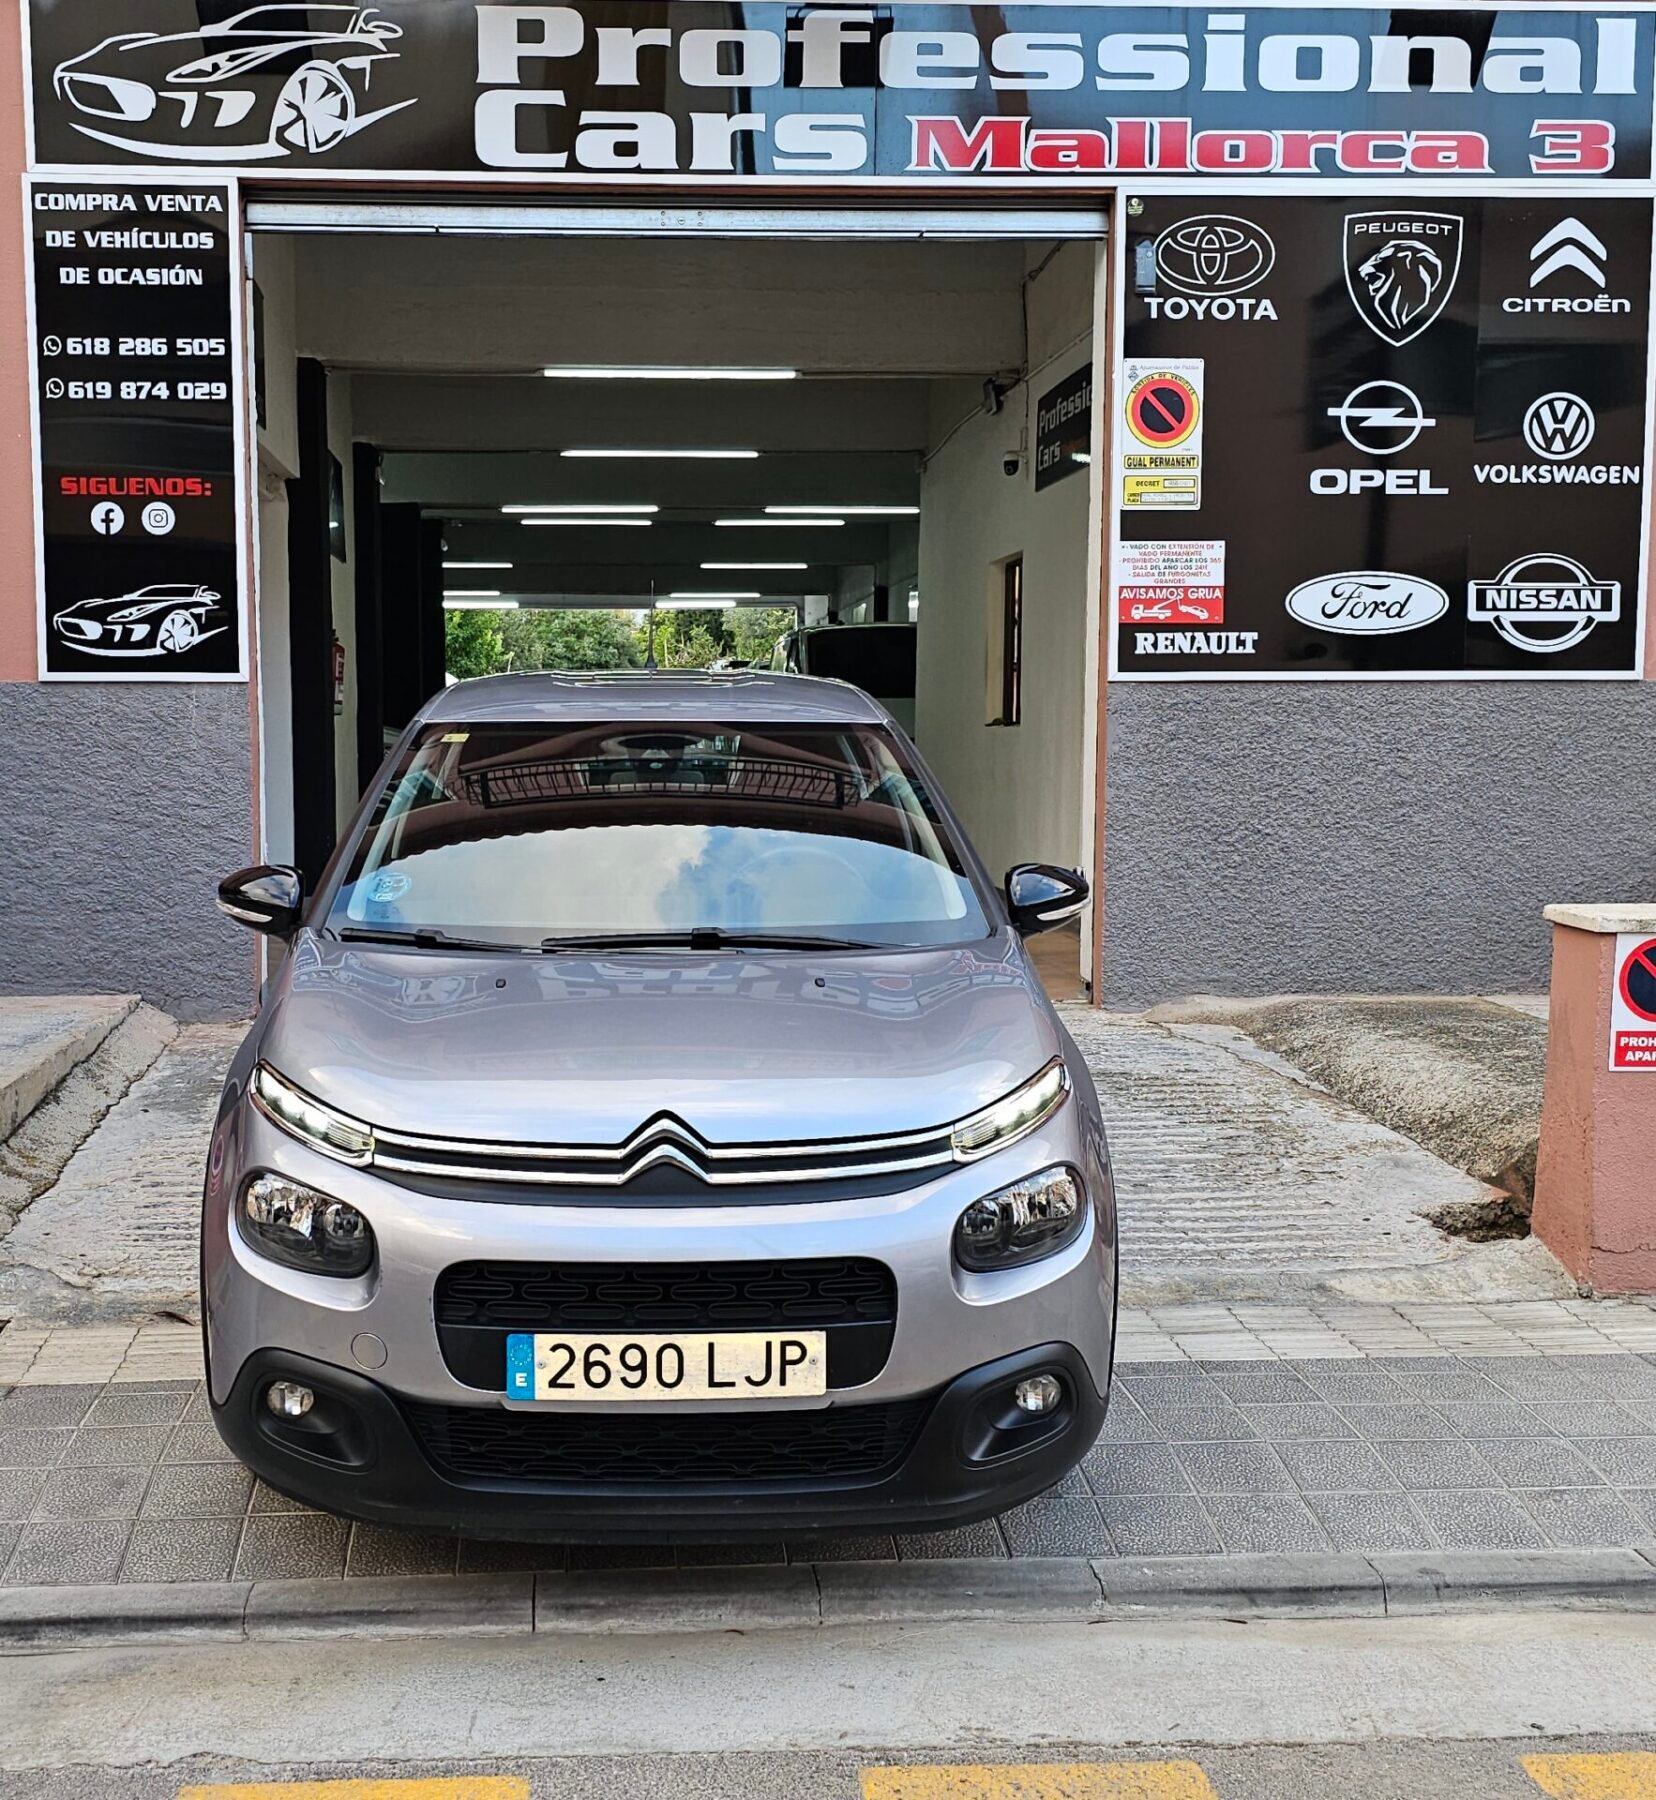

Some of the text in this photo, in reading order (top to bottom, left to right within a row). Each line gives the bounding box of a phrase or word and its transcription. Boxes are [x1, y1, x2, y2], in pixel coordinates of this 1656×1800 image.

[475, 4, 1637, 95] Professional
[474, 89, 1616, 174] Cars Mallorca 3
[34, 193, 223, 212] COMPRA VENTA
[45, 227, 214, 249] DE VEHÍCULOS
[1353, 221, 1453, 236] PEUGEOT
[59, 264, 203, 285] DE OCASIÓN
[1144, 297, 1278, 321] TOYOTA
[66, 337, 226, 356] 618 286 505
[68, 381, 227, 400] 619 874 029
[1038, 441, 1060, 471] Cars
[1127, 456, 1196, 467] GUAL PERMANENT
[1309, 468, 1449, 495] OPEL
[1473, 463, 1640, 485] VOLKSWAGEN
[60, 477, 212, 496] SIGUENOS:
[1120, 588, 1222, 599] AVISAMOS GRUA
[1321, 581, 1413, 619] Ford
[1485, 588, 1602, 610] NISSAN
[1134, 632, 1258, 655] RENAULT
[515, 1339, 808, 1389] E 2690 LJP
